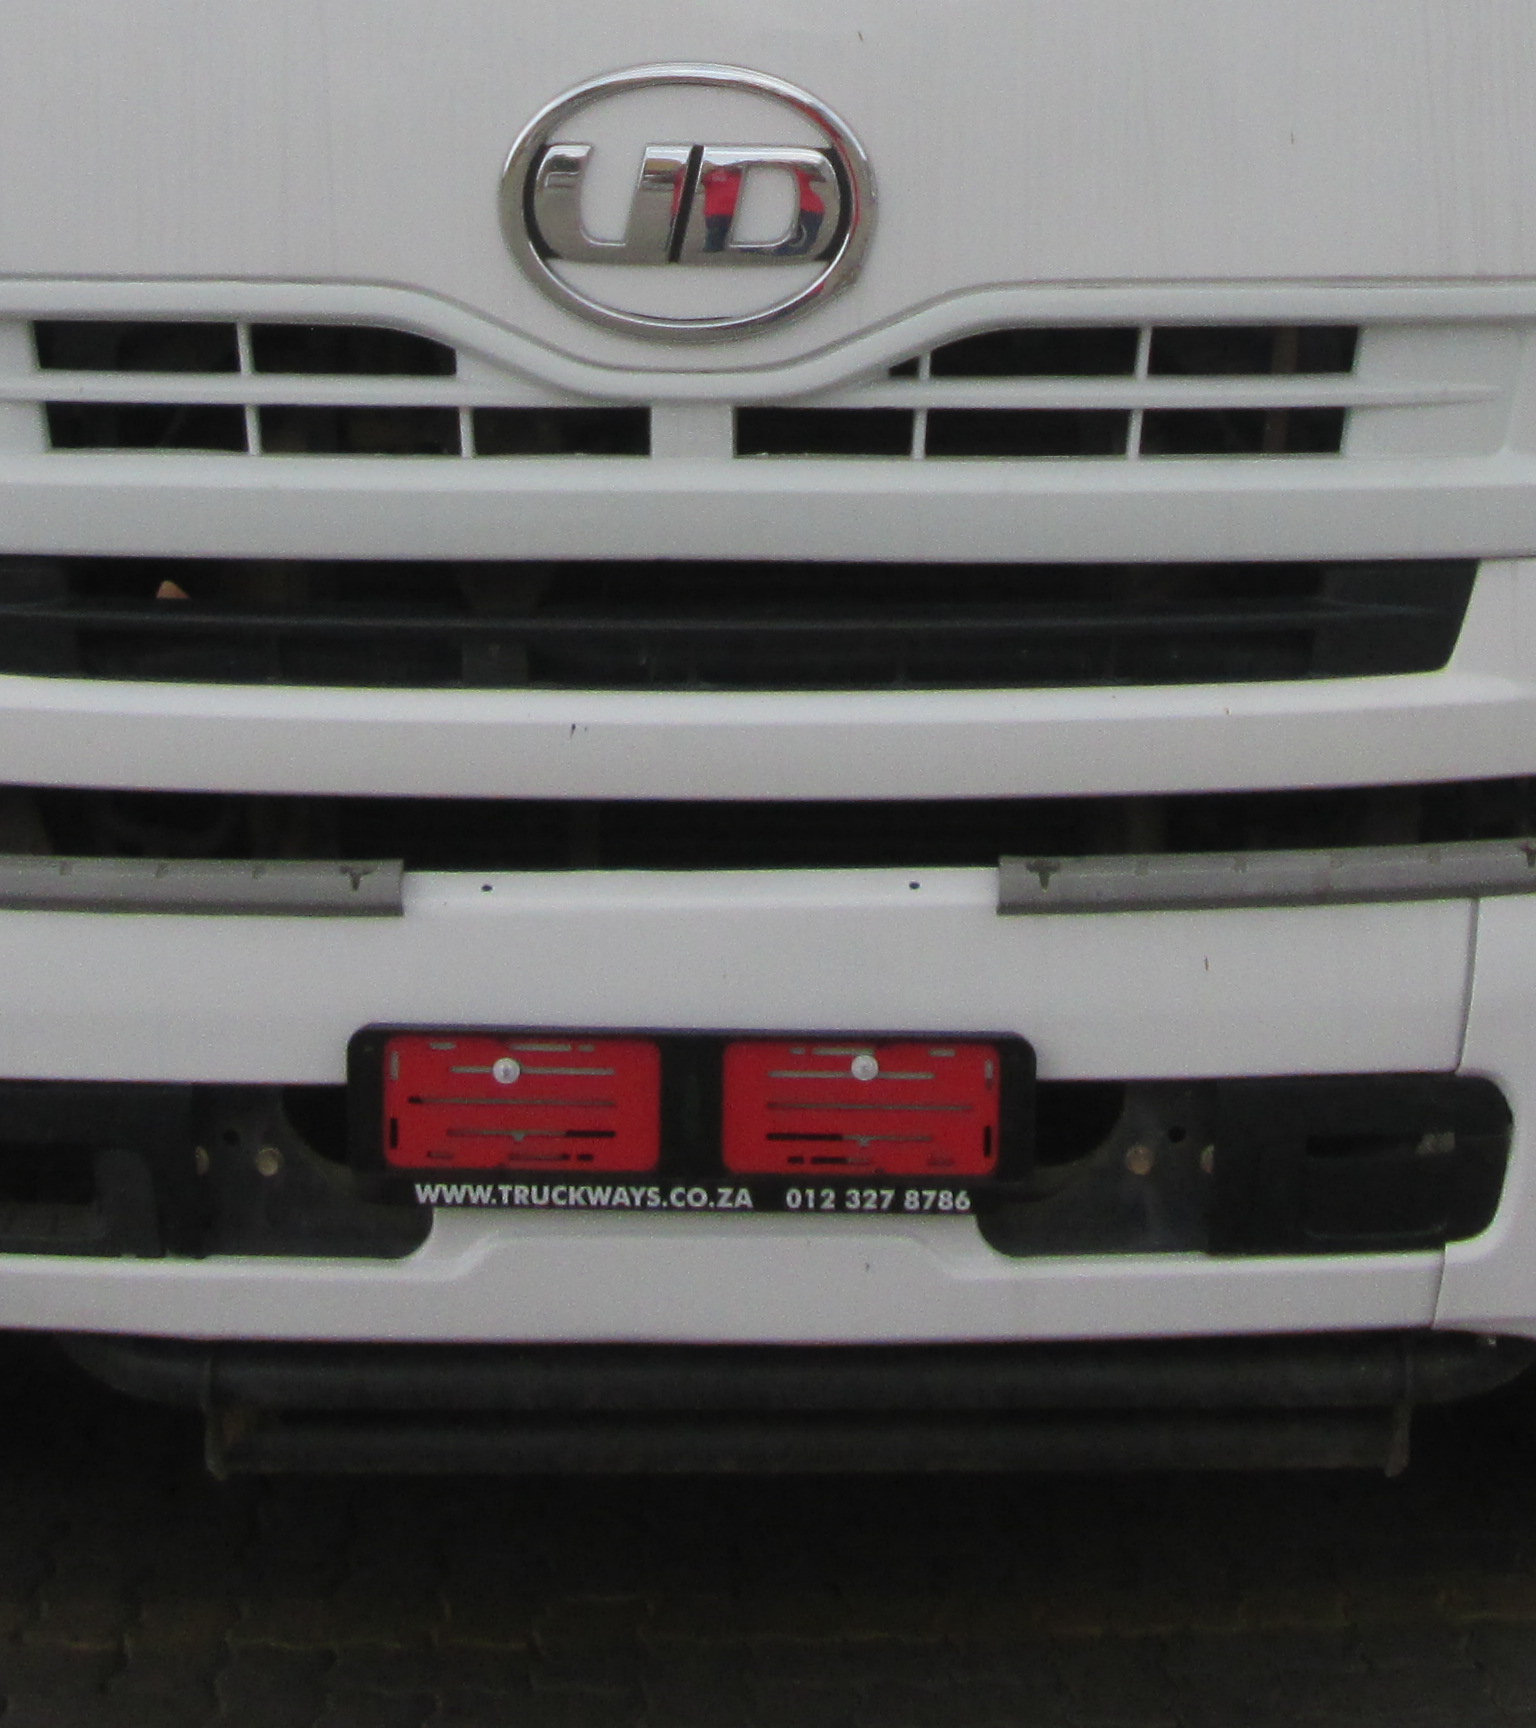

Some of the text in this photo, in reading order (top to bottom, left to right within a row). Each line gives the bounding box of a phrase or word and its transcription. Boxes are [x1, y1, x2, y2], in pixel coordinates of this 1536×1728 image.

[533, 143, 842, 266] UD
[414, 1182, 971, 1212] WWW.TRUCKWAYS.CO.ZA 012 327 8786
